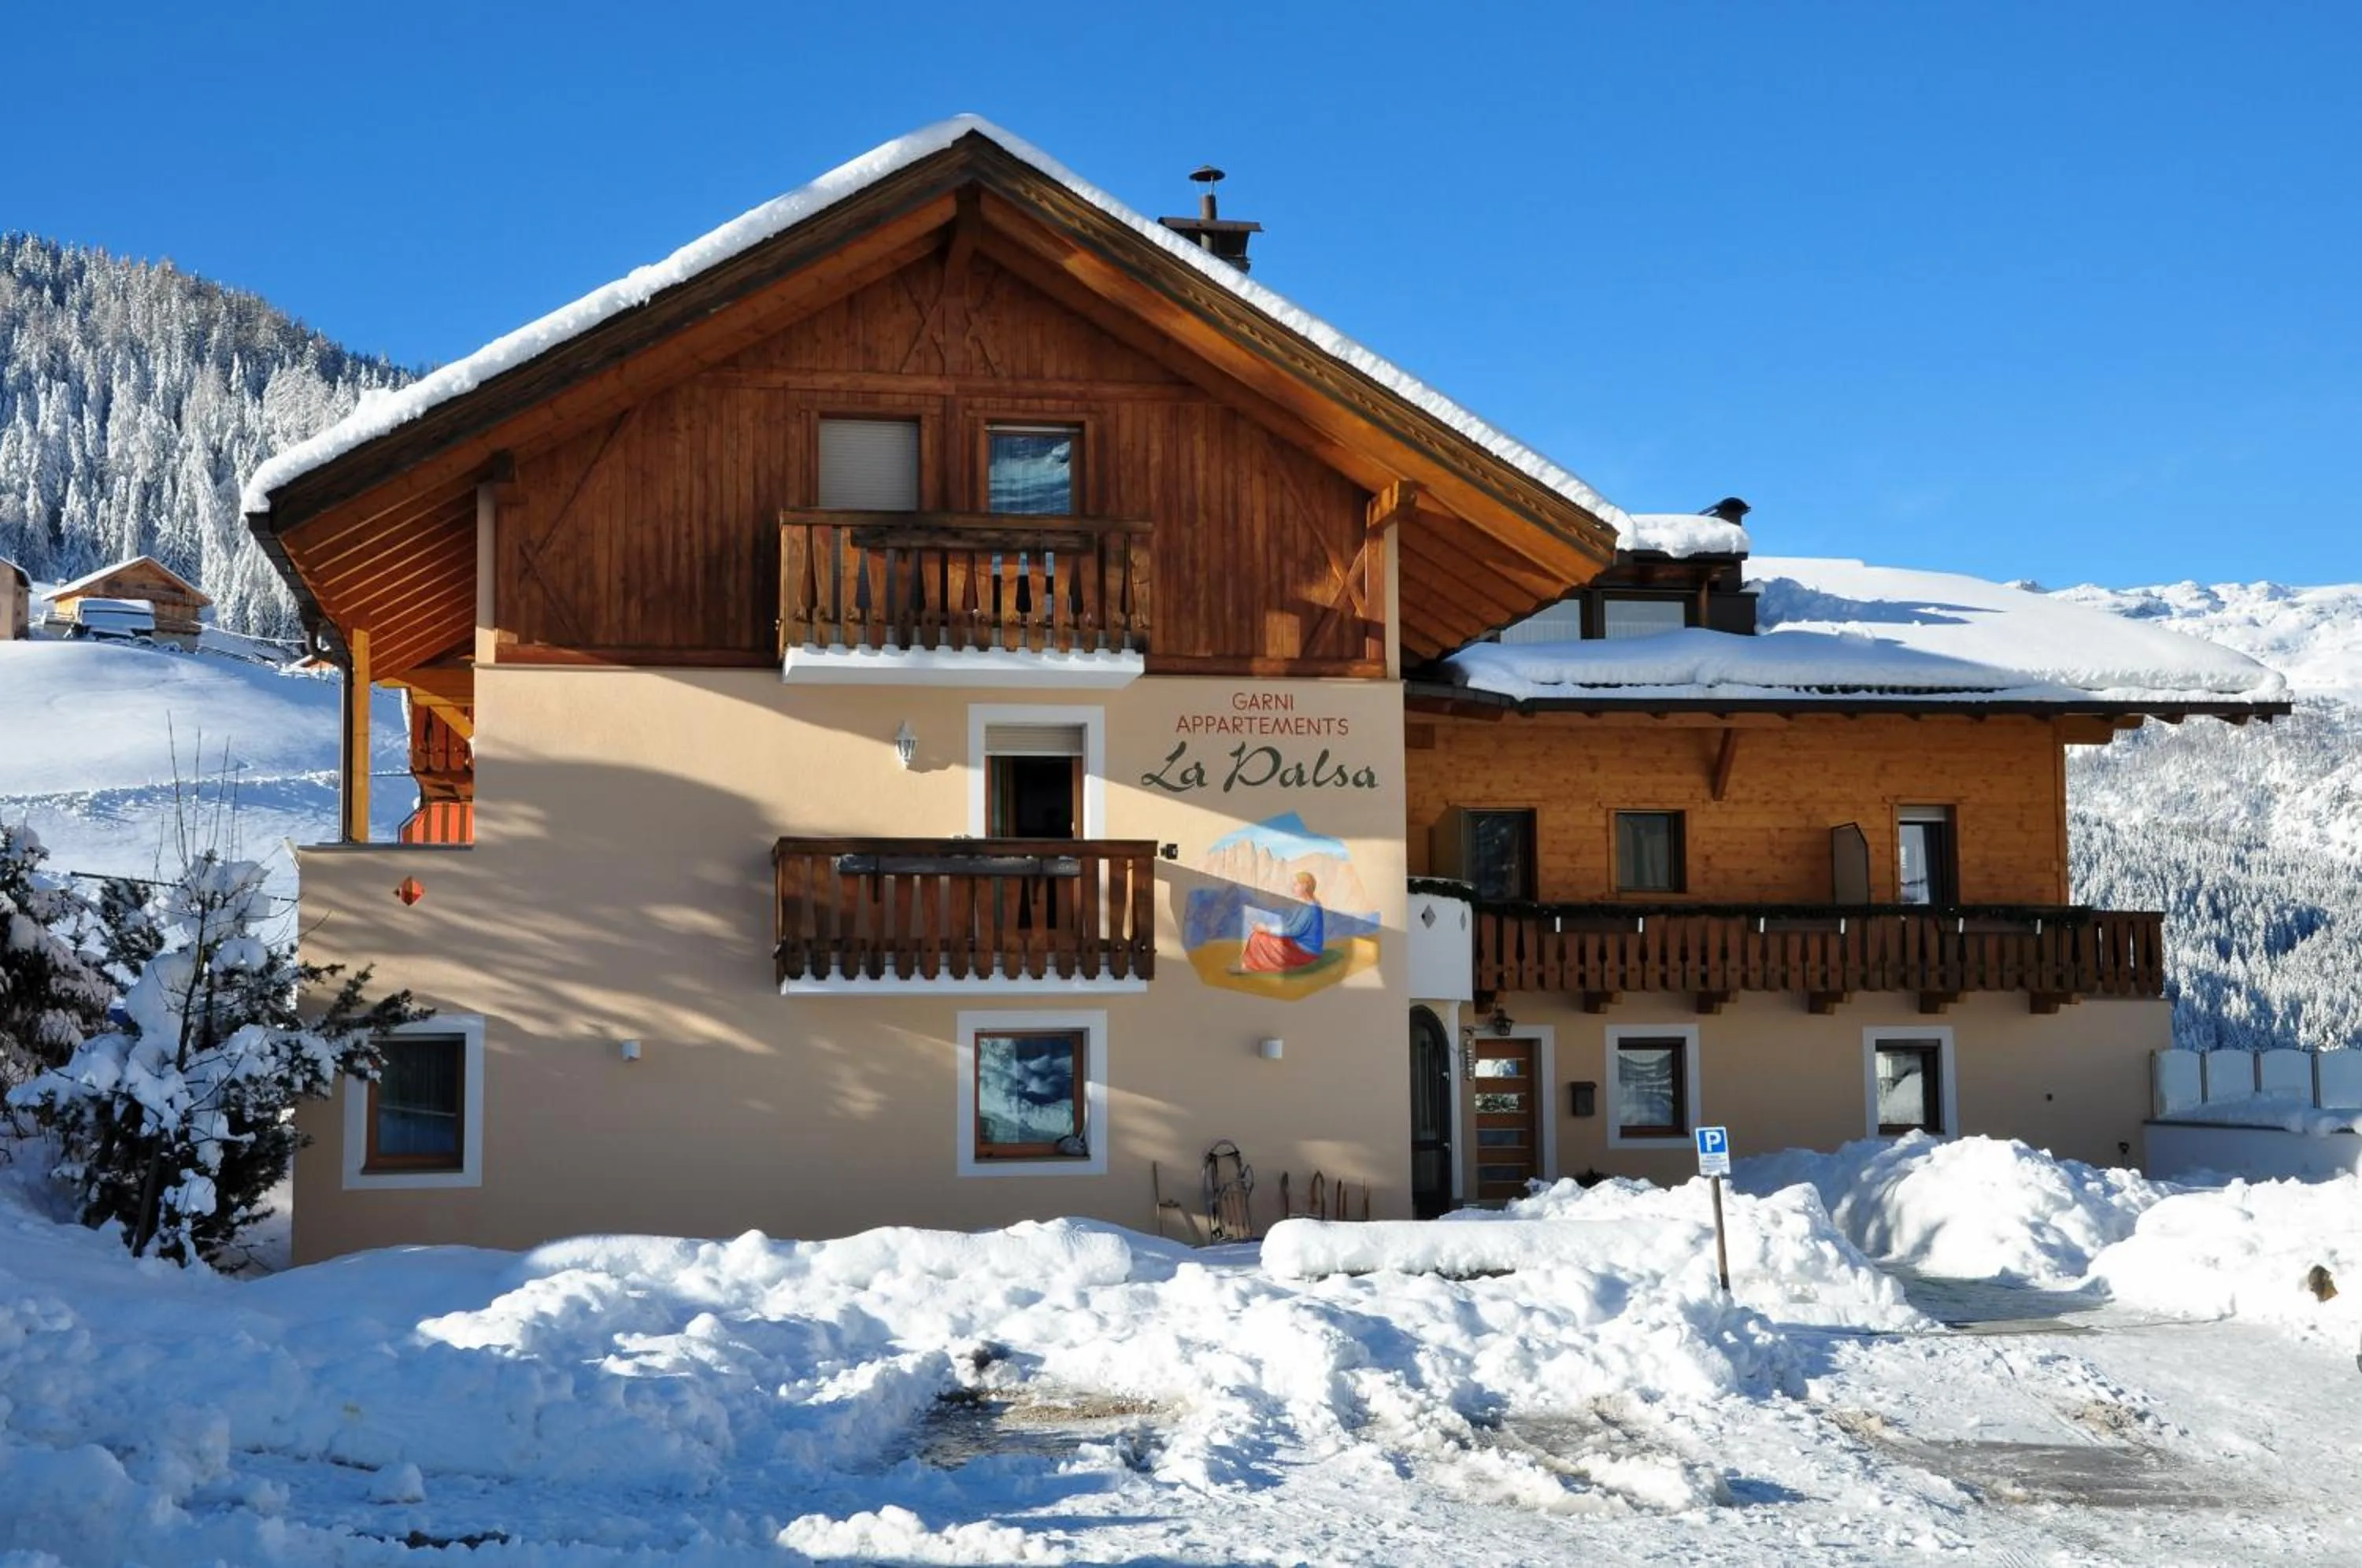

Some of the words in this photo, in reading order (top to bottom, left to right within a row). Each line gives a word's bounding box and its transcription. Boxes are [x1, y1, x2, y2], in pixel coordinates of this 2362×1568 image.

[1232, 693, 1294, 711] GARNI
[1175, 715, 1349, 735] APPARTEMENTS
[1141, 741, 1208, 792] La
[1223, 741, 1379, 793] Palsa
[1705, 1131, 1722, 1153] P
